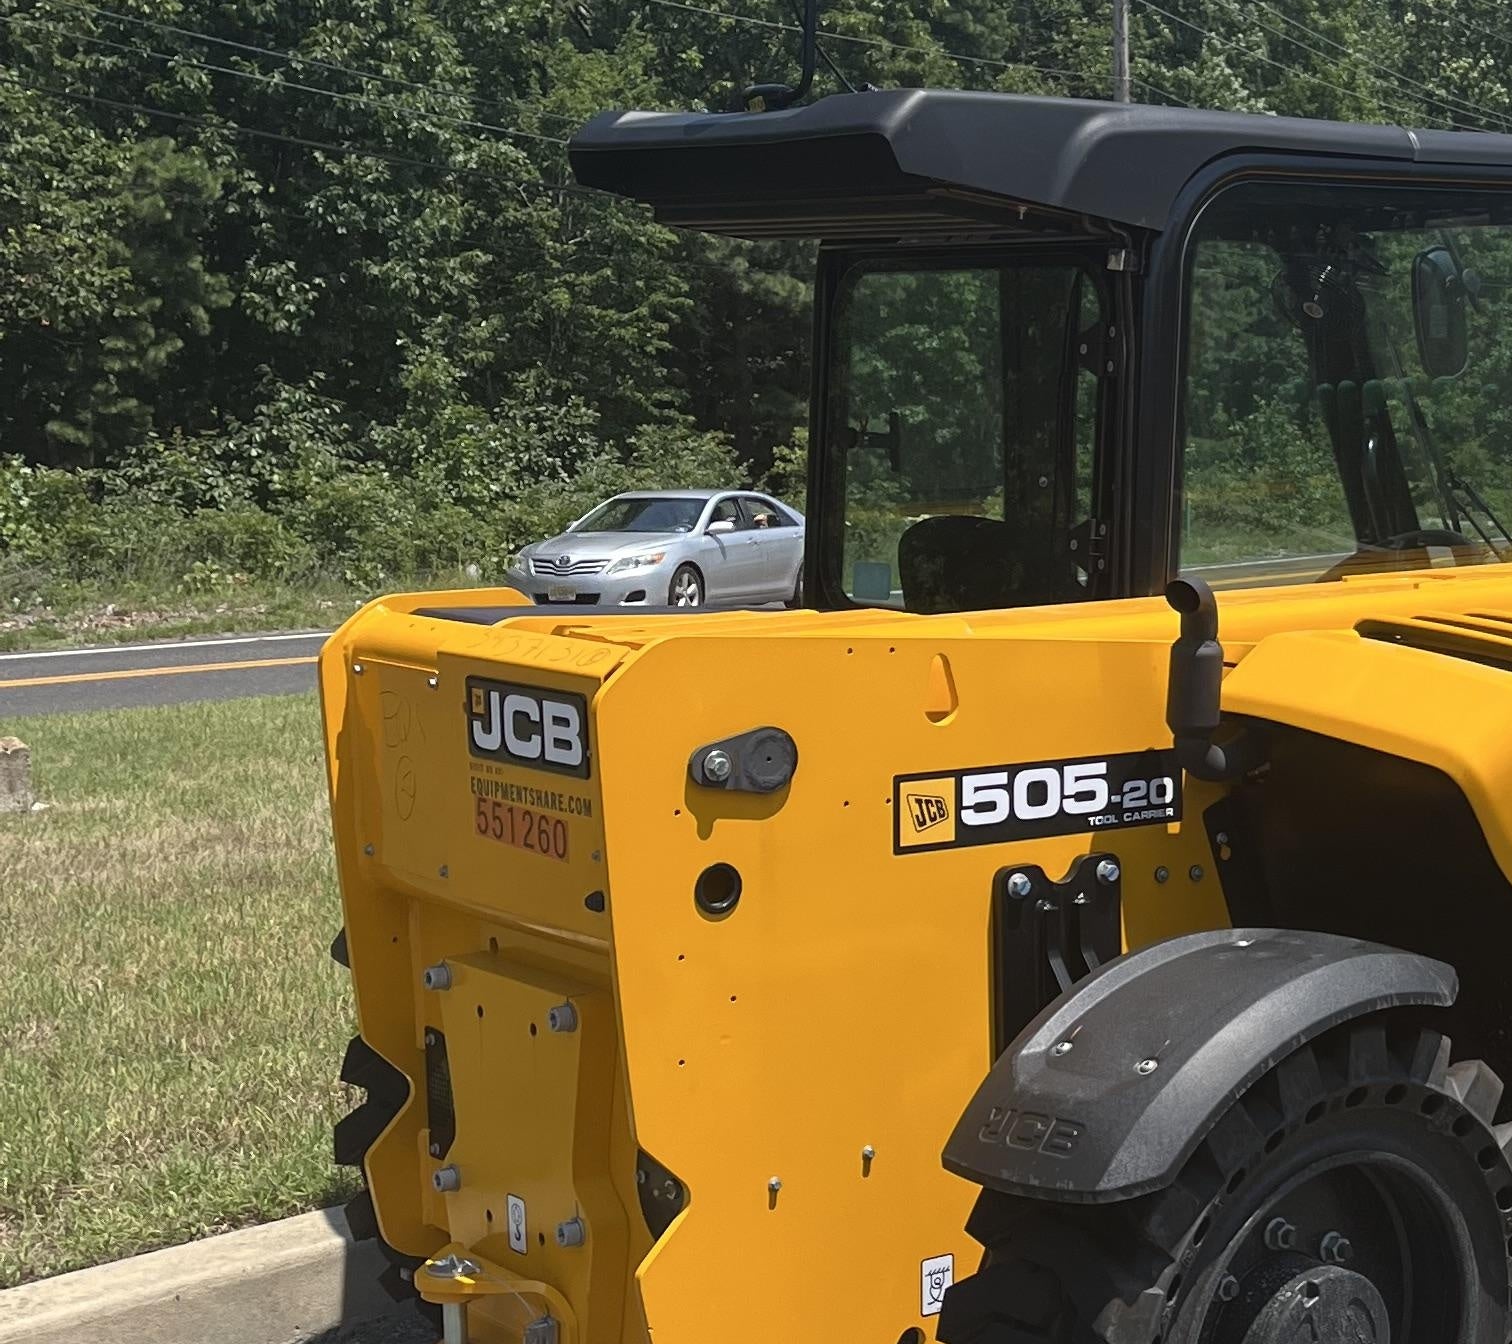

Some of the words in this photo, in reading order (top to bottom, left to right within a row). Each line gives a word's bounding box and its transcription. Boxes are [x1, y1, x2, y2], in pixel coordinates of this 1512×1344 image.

[472, 690, 583, 767] JCB
[470, 776, 593, 818] EQUIPMENTSHARE.COM
[914, 797, 946, 828] JCB
[960, 761, 1174, 826] 505-20
[1088, 815, 1119, 826] TOOL
[1123, 807, 1174, 822] CARRIER
[476, 796, 568, 859] 551260
[979, 1107, 1086, 1159] JCB
